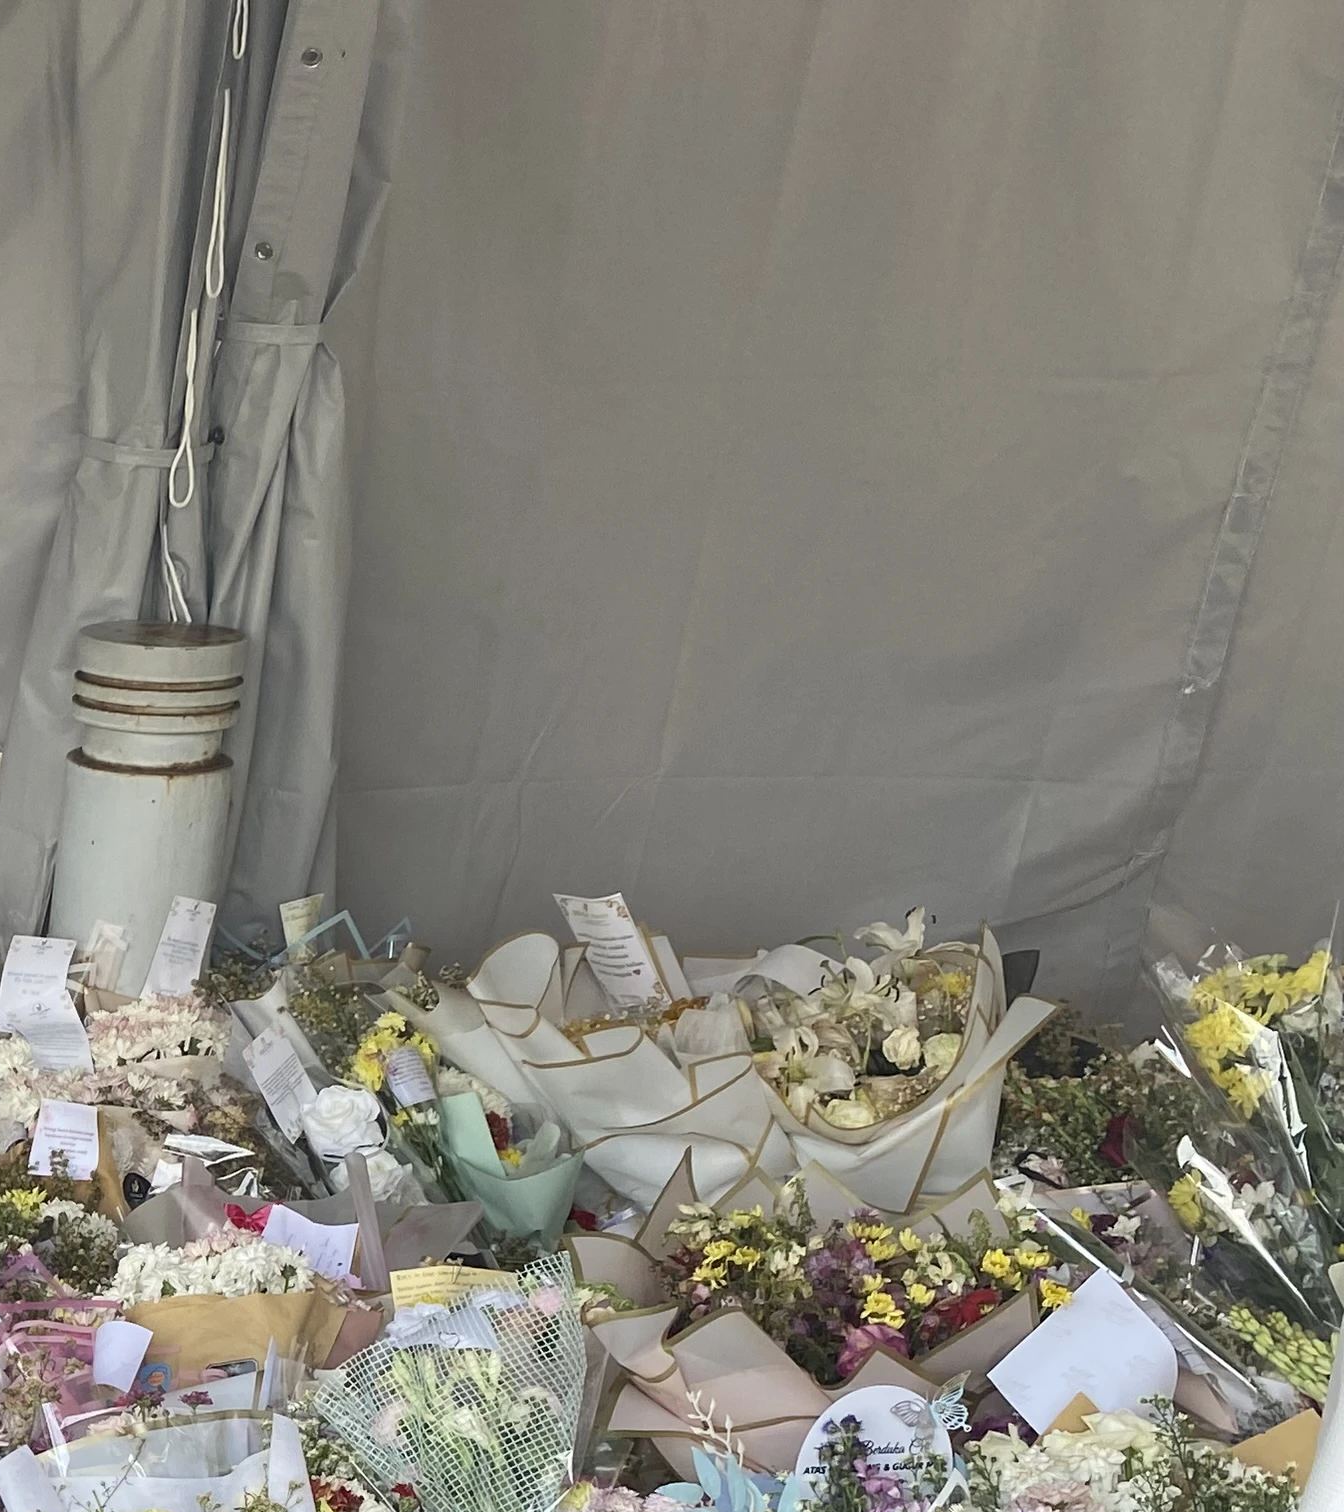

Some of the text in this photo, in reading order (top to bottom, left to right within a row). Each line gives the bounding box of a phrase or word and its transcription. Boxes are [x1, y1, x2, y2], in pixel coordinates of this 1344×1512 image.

[862, 1440, 905, 1456] Berduka
[803, 1465, 828, 1475] ATAS
[883, 1463, 890, 1471] &
